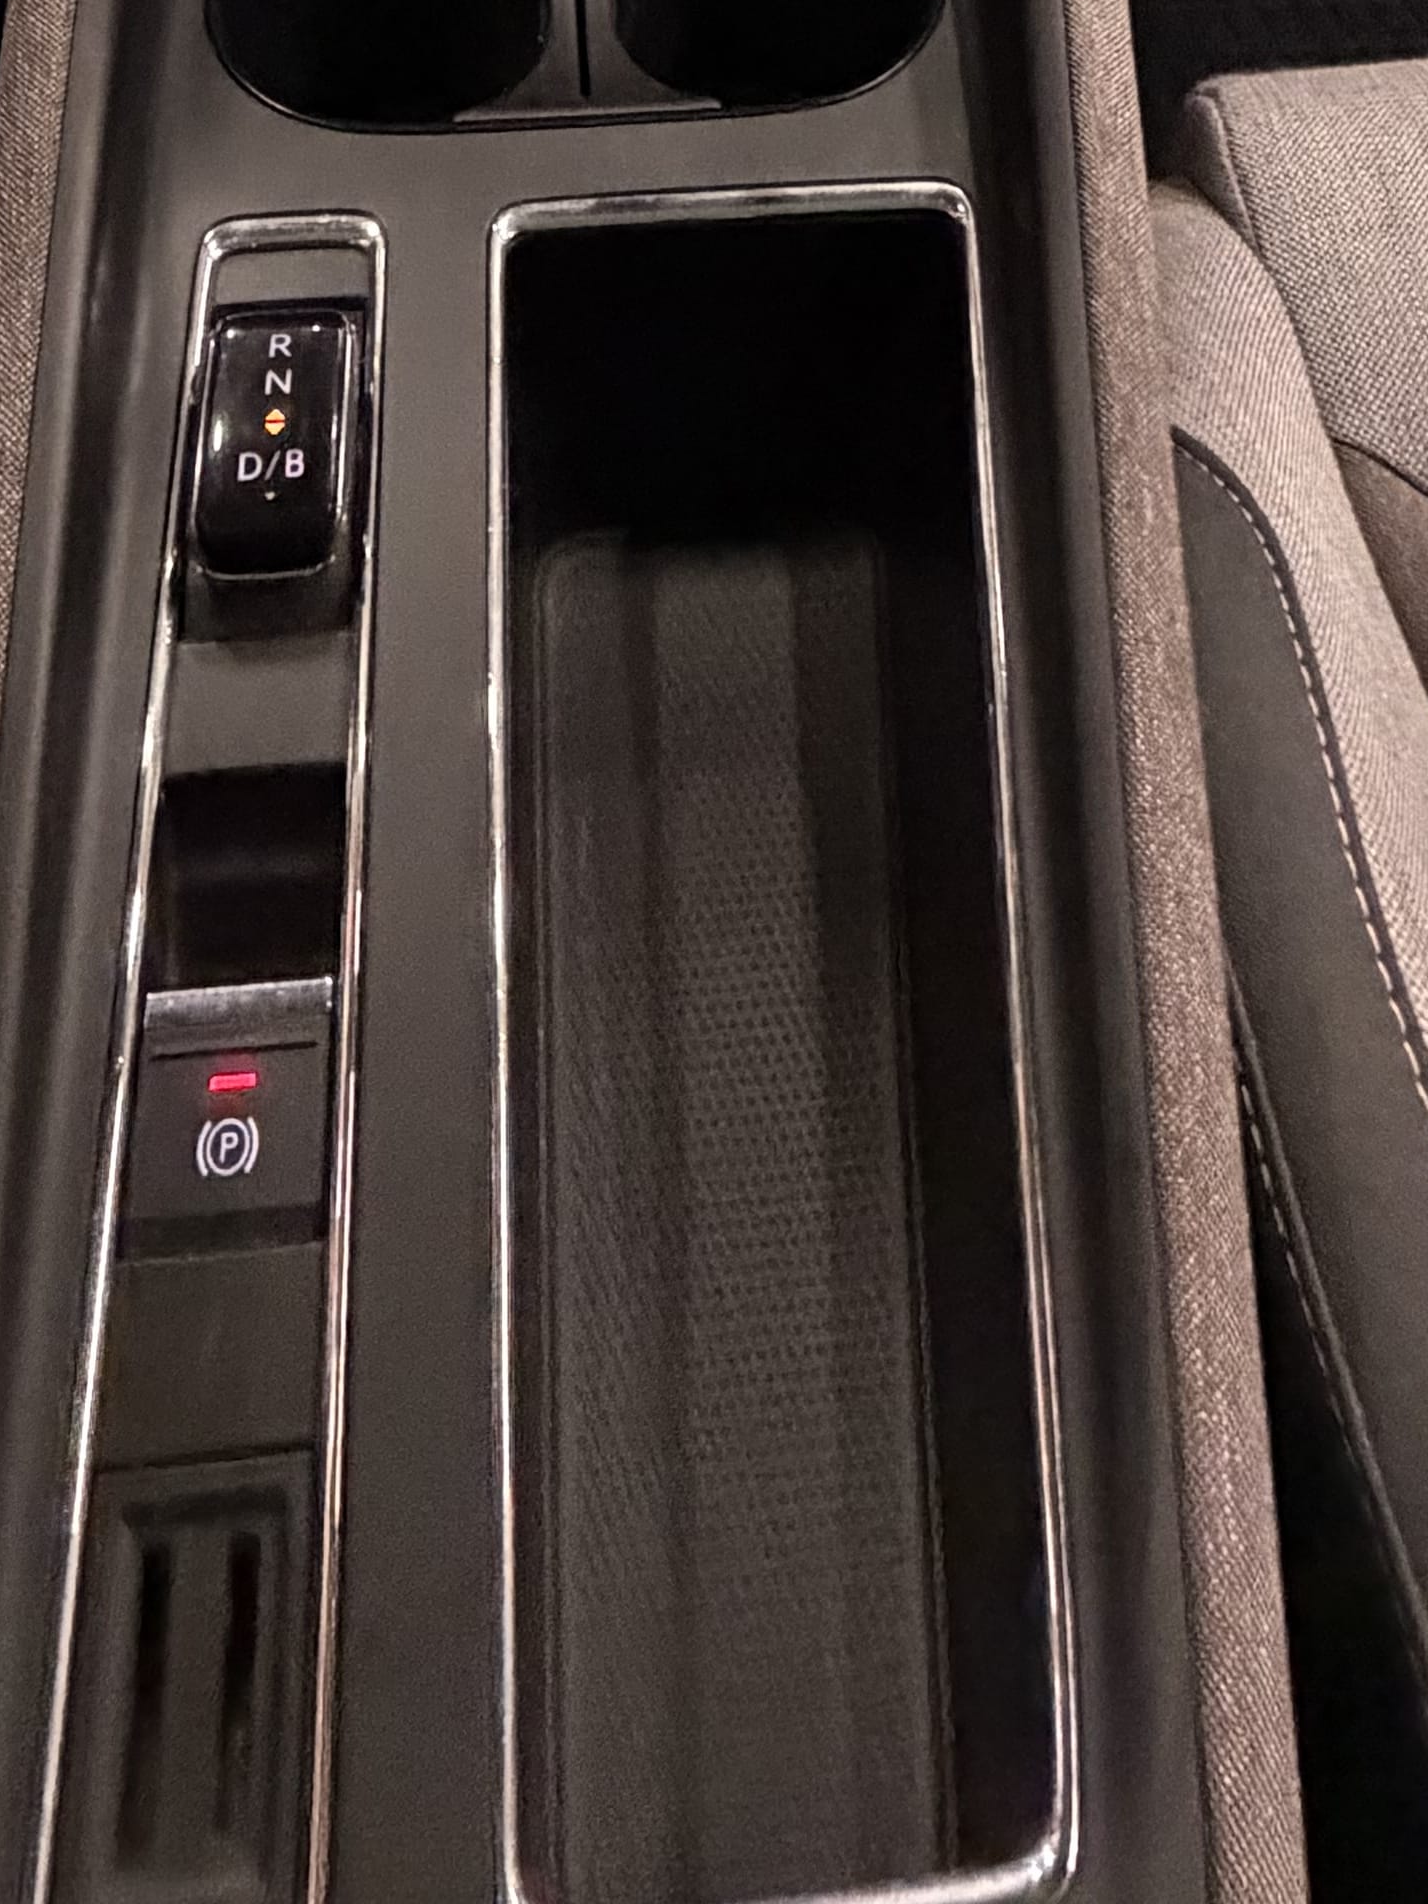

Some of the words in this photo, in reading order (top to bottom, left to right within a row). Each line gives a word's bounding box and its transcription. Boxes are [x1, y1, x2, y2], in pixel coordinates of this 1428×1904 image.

[268, 332, 293, 359] R
[264, 367, 293, 396] N
[236, 448, 306, 482] D/B
